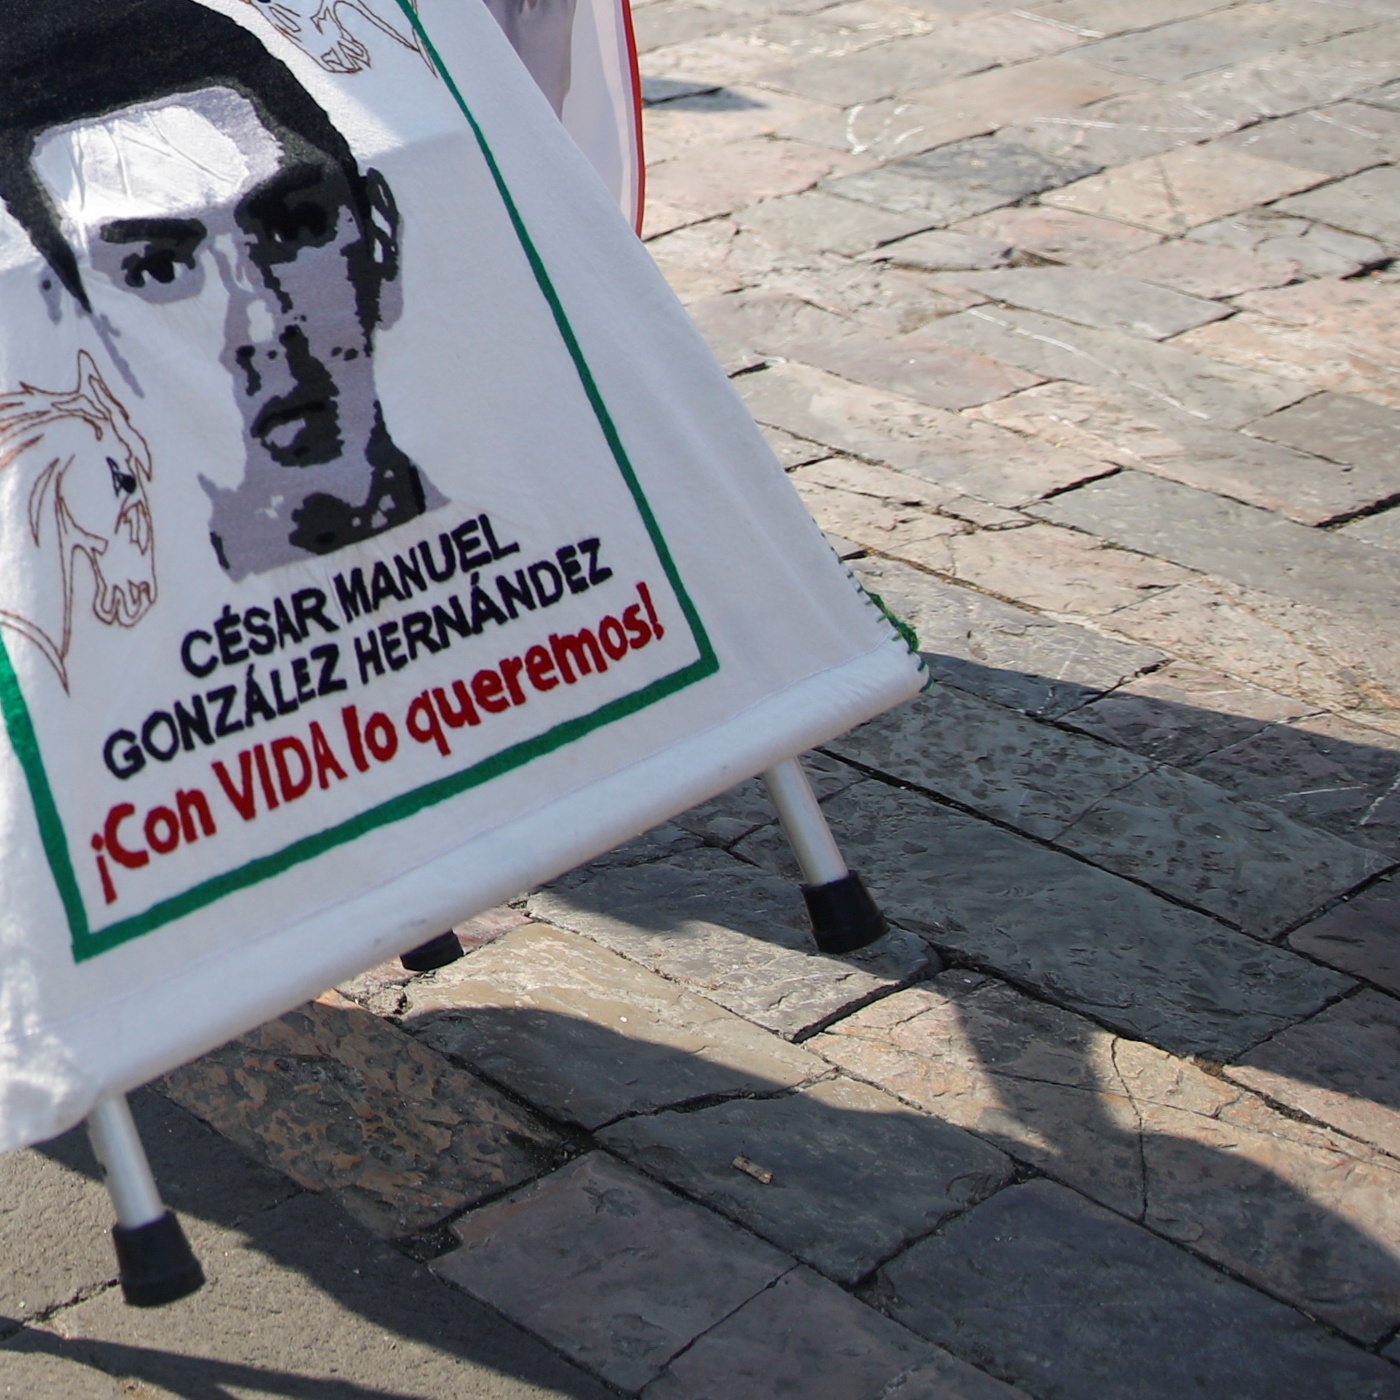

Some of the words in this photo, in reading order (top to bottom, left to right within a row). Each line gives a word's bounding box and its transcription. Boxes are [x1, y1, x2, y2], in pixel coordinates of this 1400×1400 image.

[103, 642, 348, 780] GONZÁLEZ
[355, 537, 613, 685] HERNÁNDEZ
[181, 582, 334, 678] CÉSAR
[332, 513, 520, 625] MANUEL
[91, 788, 217, 904] ¡Con
[210, 721, 347, 821] VIDA
[342, 705, 399, 773] lo
[404, 581, 664, 757] queremos!
